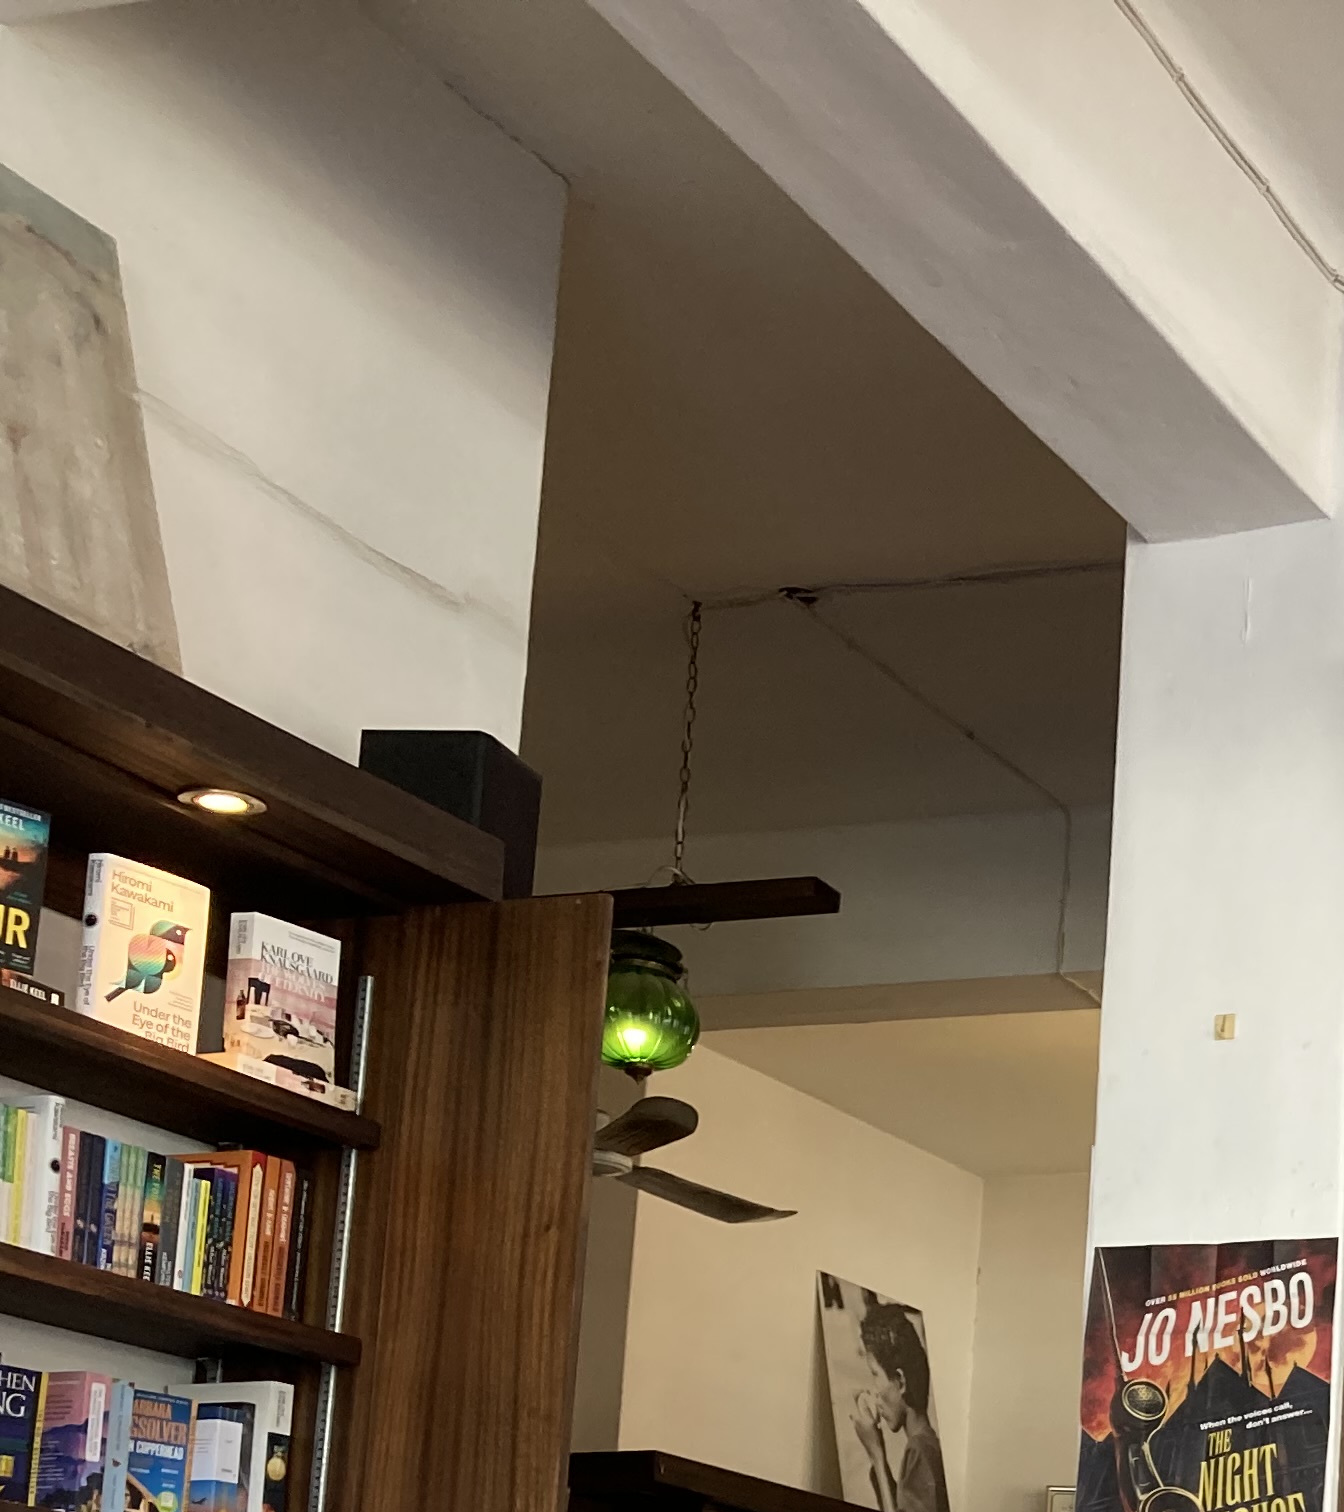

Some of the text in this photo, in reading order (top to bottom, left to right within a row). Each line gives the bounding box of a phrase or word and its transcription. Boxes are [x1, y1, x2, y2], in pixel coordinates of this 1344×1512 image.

[112, 869, 152, 893] Hiromi
[111, 882, 174, 912] Kawakami
[261, 954, 334, 985] KNAUSGAARD
[291, 951, 314, 967] OVE
[132, 1014, 191, 1041] Eye of the
[133, 1001, 192, 1028] Under the
[167, 1035, 189, 1053] Bird
[1145, 1296, 1166, 1307] OVER
[1260, 1258, 1307, 1277] WORLDWIDE
[1121, 1308, 1176, 1373] JO
[1200, 1400, 1294, 1431] When the voices call,
[1245, 1416, 1270, 1430] don't
[1207, 1428, 1232, 1457] THE
[1199, 1443, 1277, 1512] NIGHT
